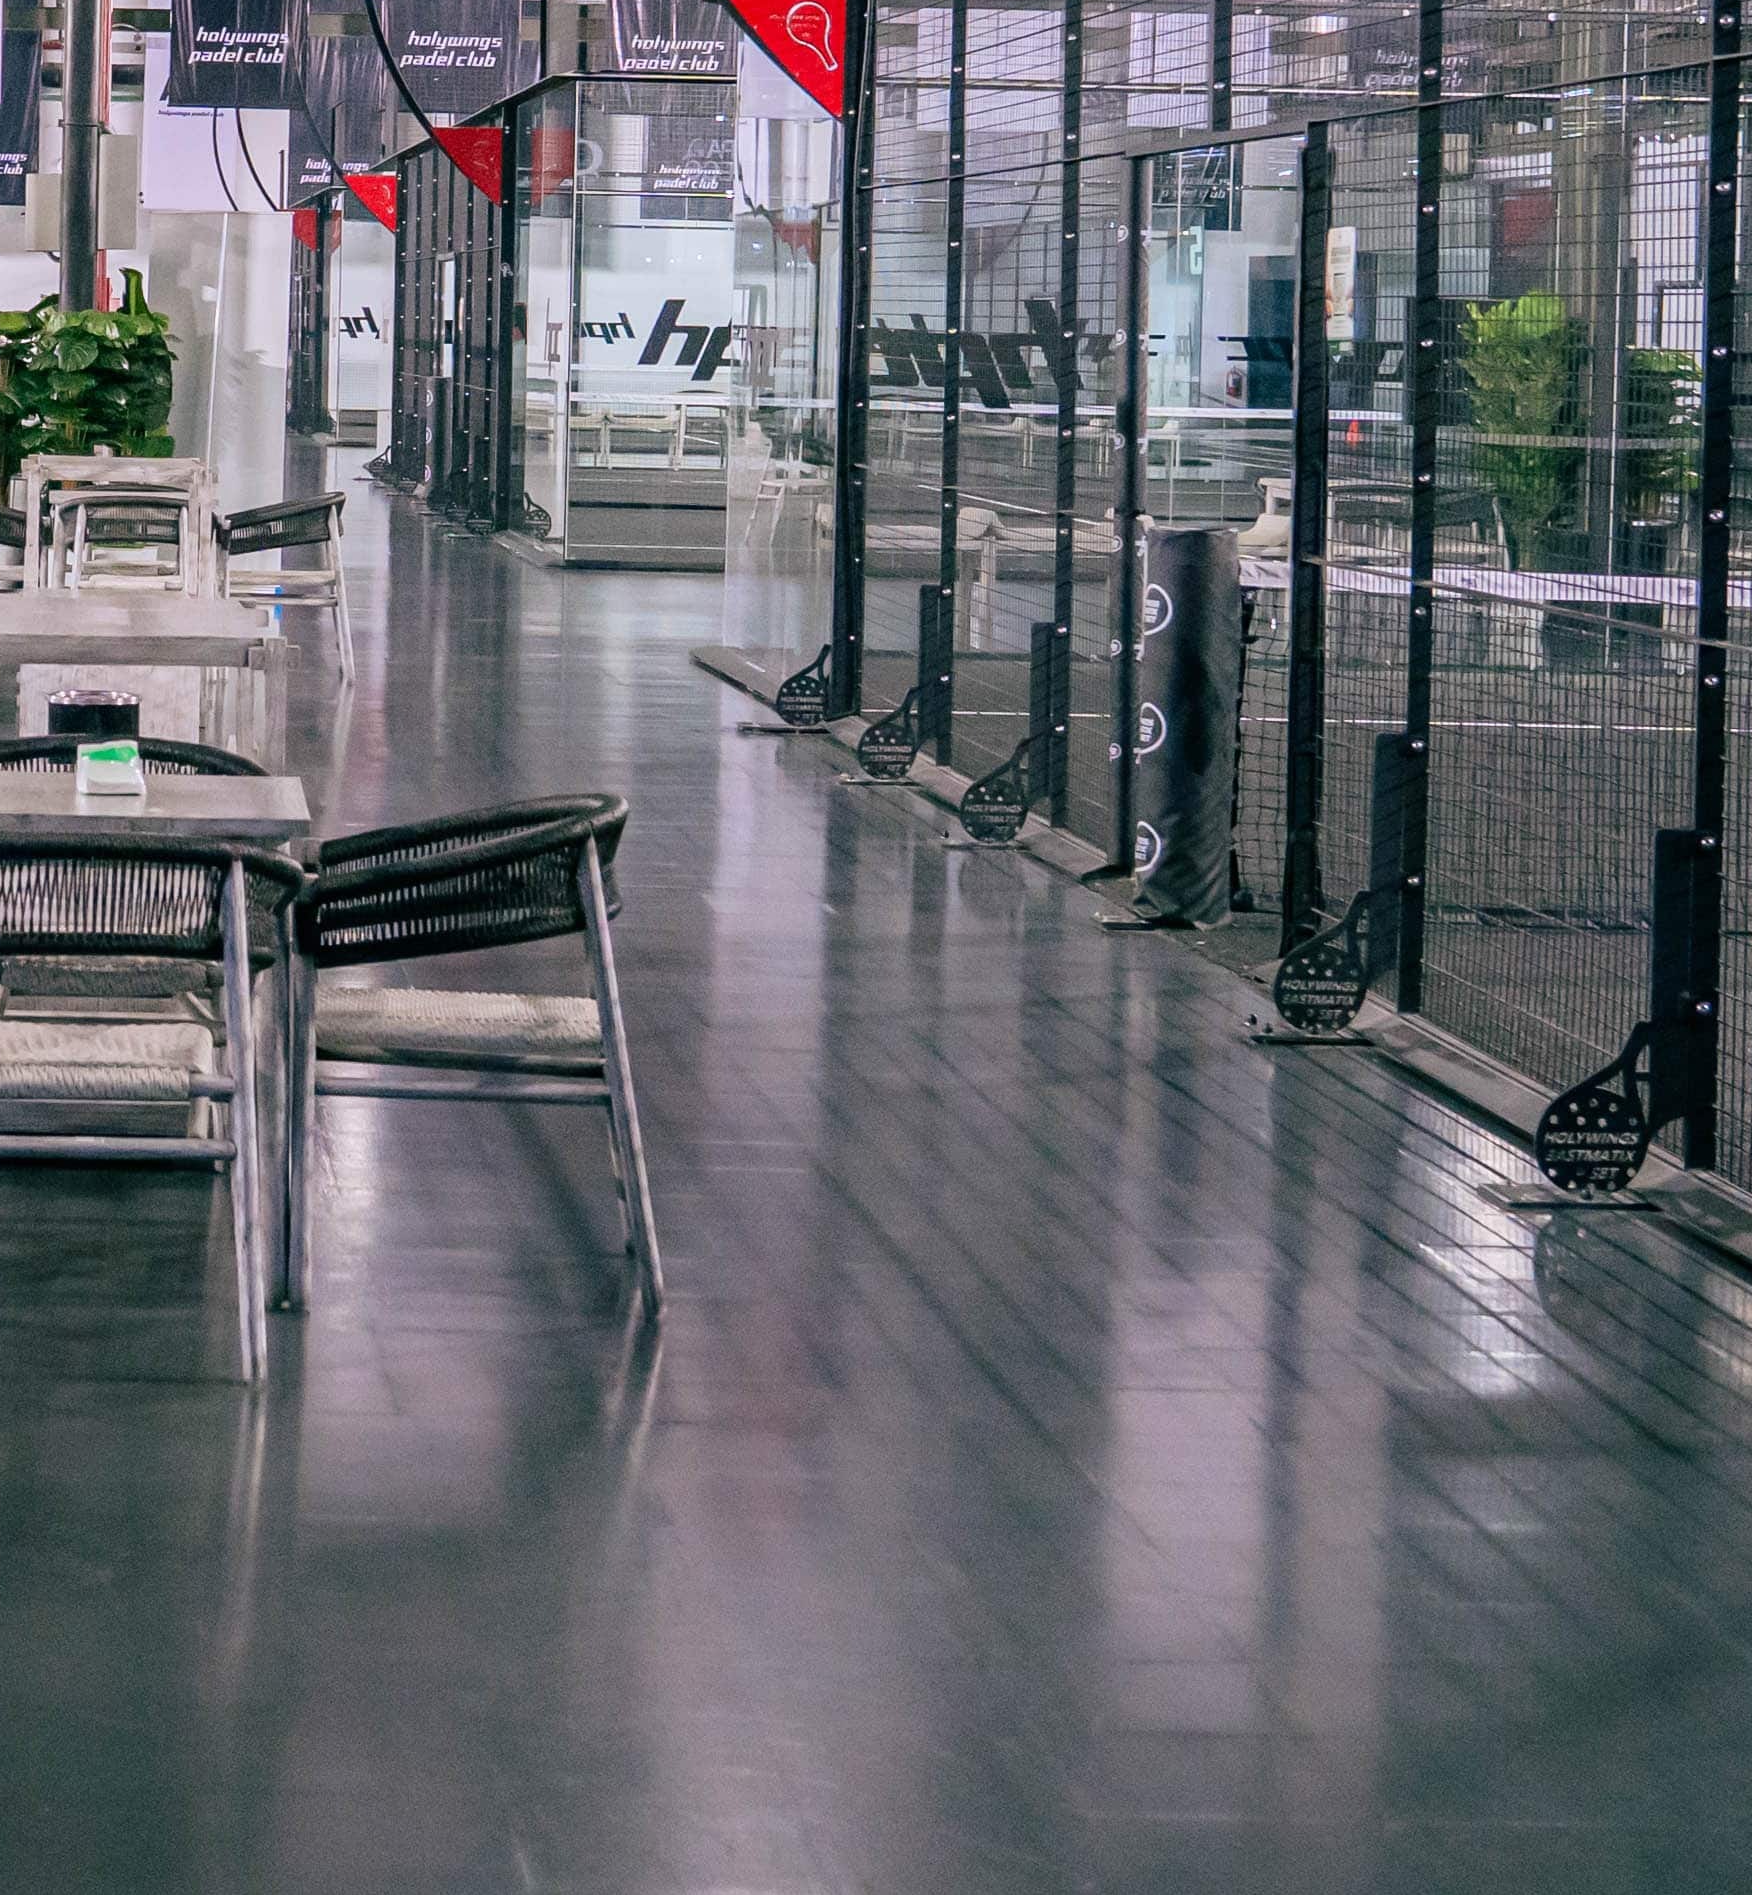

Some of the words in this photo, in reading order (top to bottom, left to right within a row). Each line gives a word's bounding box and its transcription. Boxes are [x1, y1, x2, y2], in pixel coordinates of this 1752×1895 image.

[197, 26, 289, 47] holywings
[408, 30, 503, 51] holywings
[632, 34, 726, 54] holywings
[188, 47, 243, 64] padel
[245, 47, 286, 64] club
[400, 50, 455, 68] padel
[456, 51, 497, 67] club
[623, 54, 678, 72] padel
[679, 54, 720, 71] club
[691, 175, 720, 190] club
[1543, 1132, 1640, 1145] HOLYWINGS
